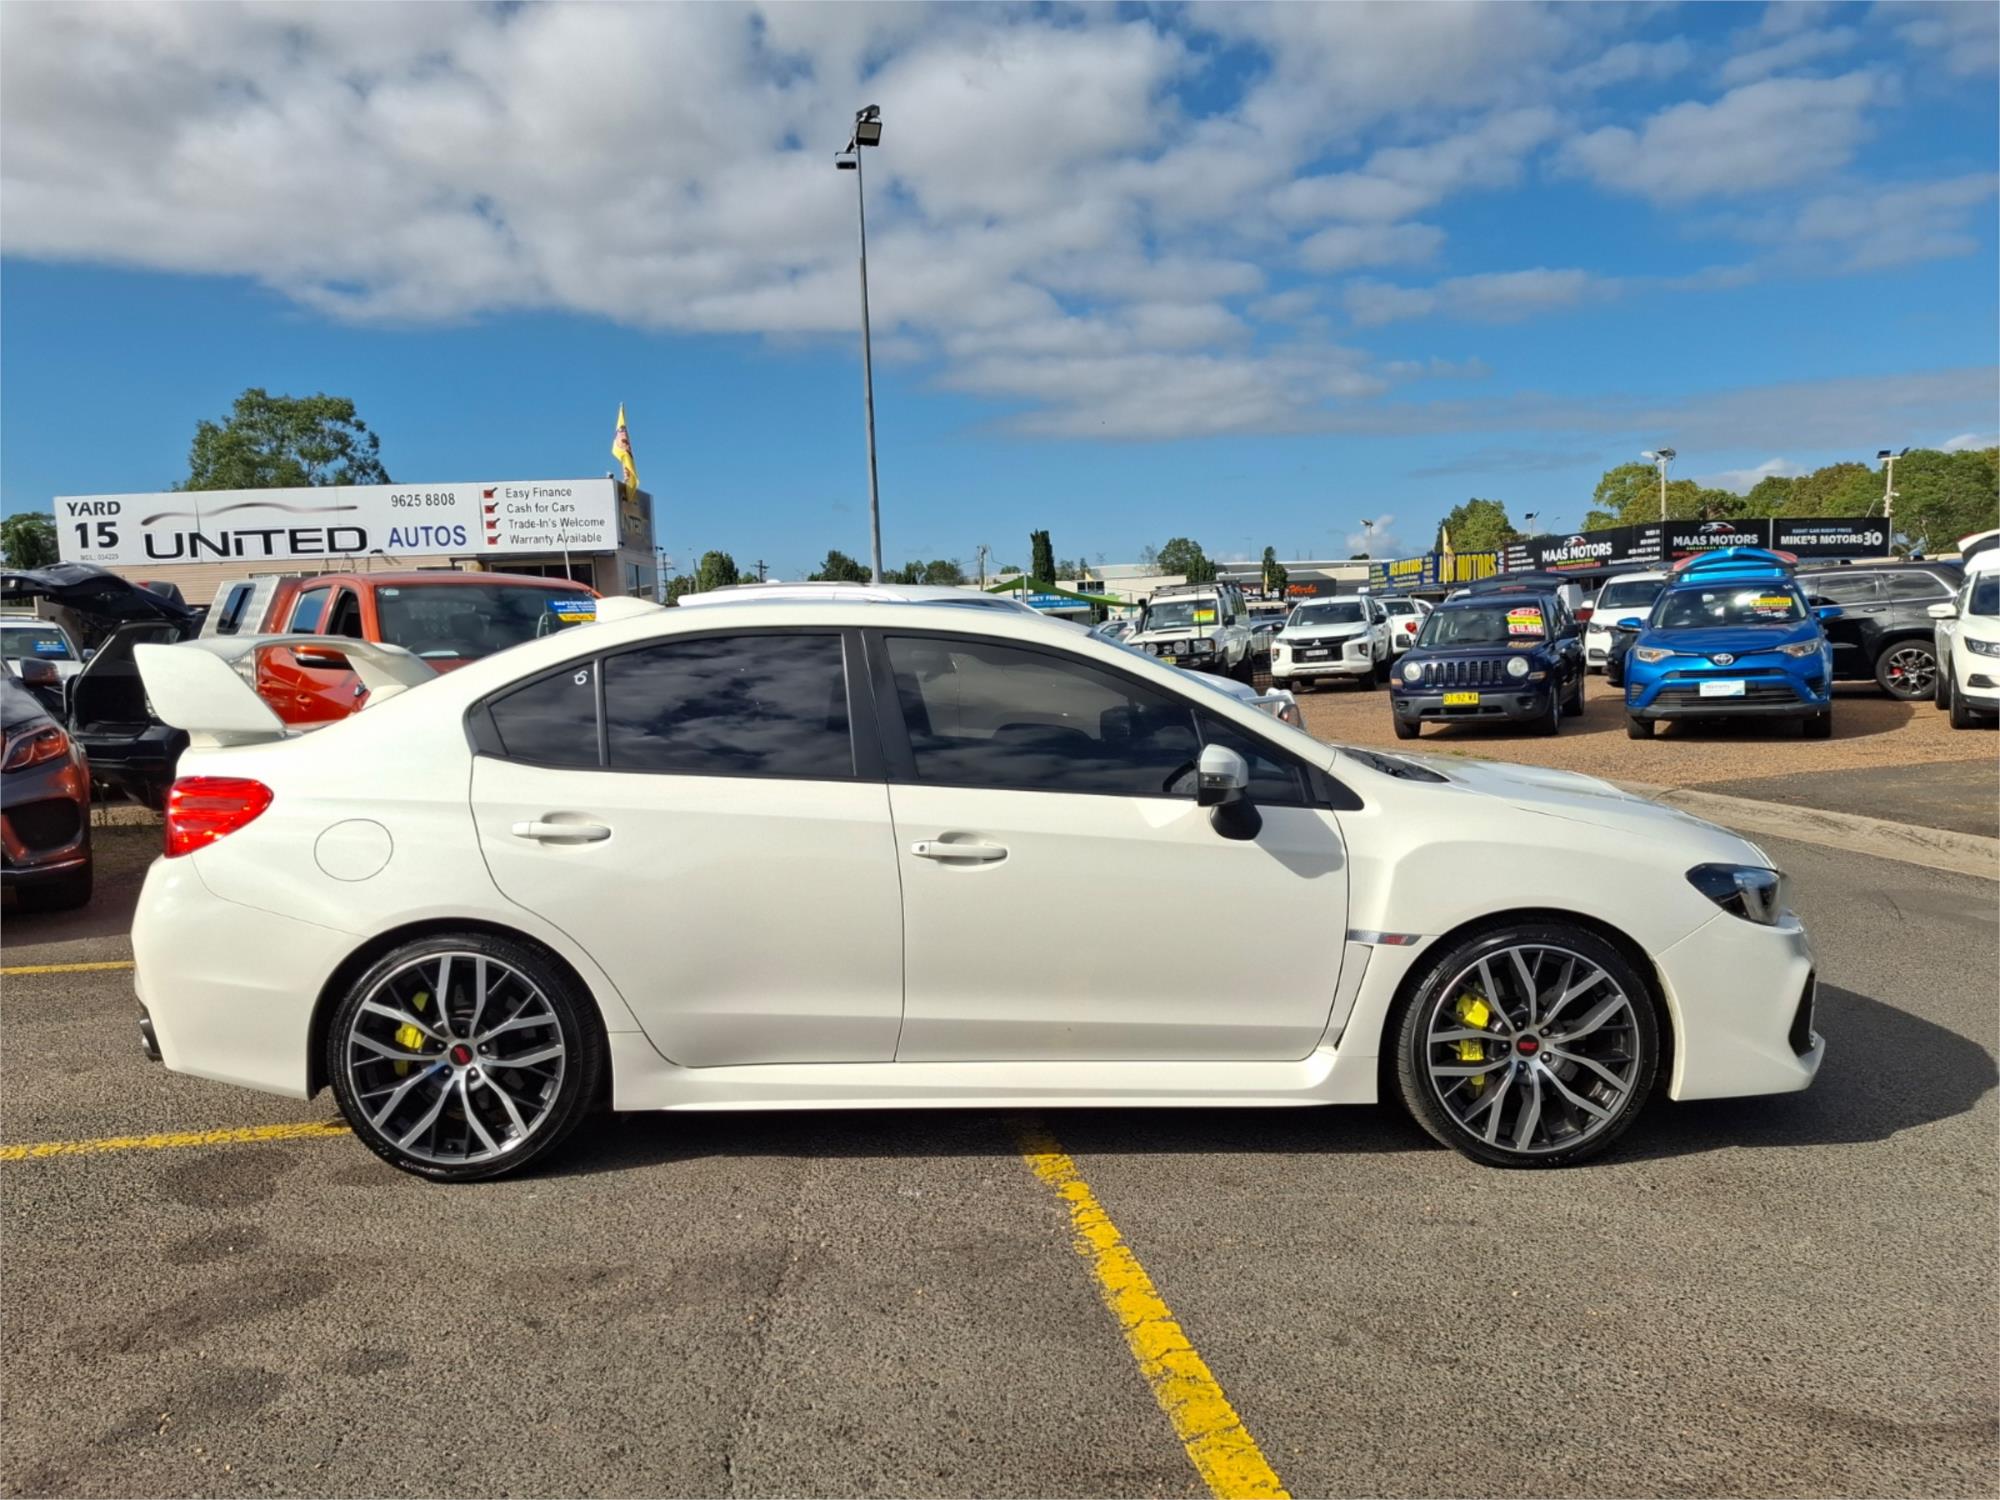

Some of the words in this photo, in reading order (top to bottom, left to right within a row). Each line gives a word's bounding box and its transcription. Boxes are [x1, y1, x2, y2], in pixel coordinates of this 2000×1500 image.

[506, 487, 529, 499] Easy
[533, 486, 572, 498] Finance
[391, 495, 422, 507] 9625
[425, 493, 456, 506] 8808
[67, 501, 121, 517] YARD
[507, 503, 532, 514] Cash
[535, 502, 549, 513] for
[551, 502, 575, 512] Cars
[508, 517, 557, 529] Trade-In's
[560, 517, 605, 528] Welcome
[74, 521, 119, 549] 15
[388, 525, 467, 548] AUTOS
[509, 534, 554, 546] Warranty
[556, 532, 602, 544] Available
[1672, 536, 1707, 546] MAAS
[1709, 534, 1758, 545] MOTORS
[1781, 535, 1817, 545] MIKE'S
[1819, 534, 1862, 544] MOTORS
[1863, 531, 1883, 546] 30
[1542, 547, 1568, 562] MAAS
[1570, 542, 1612, 559] MOTORS
[1456, 553, 1496, 582] MOTORS
